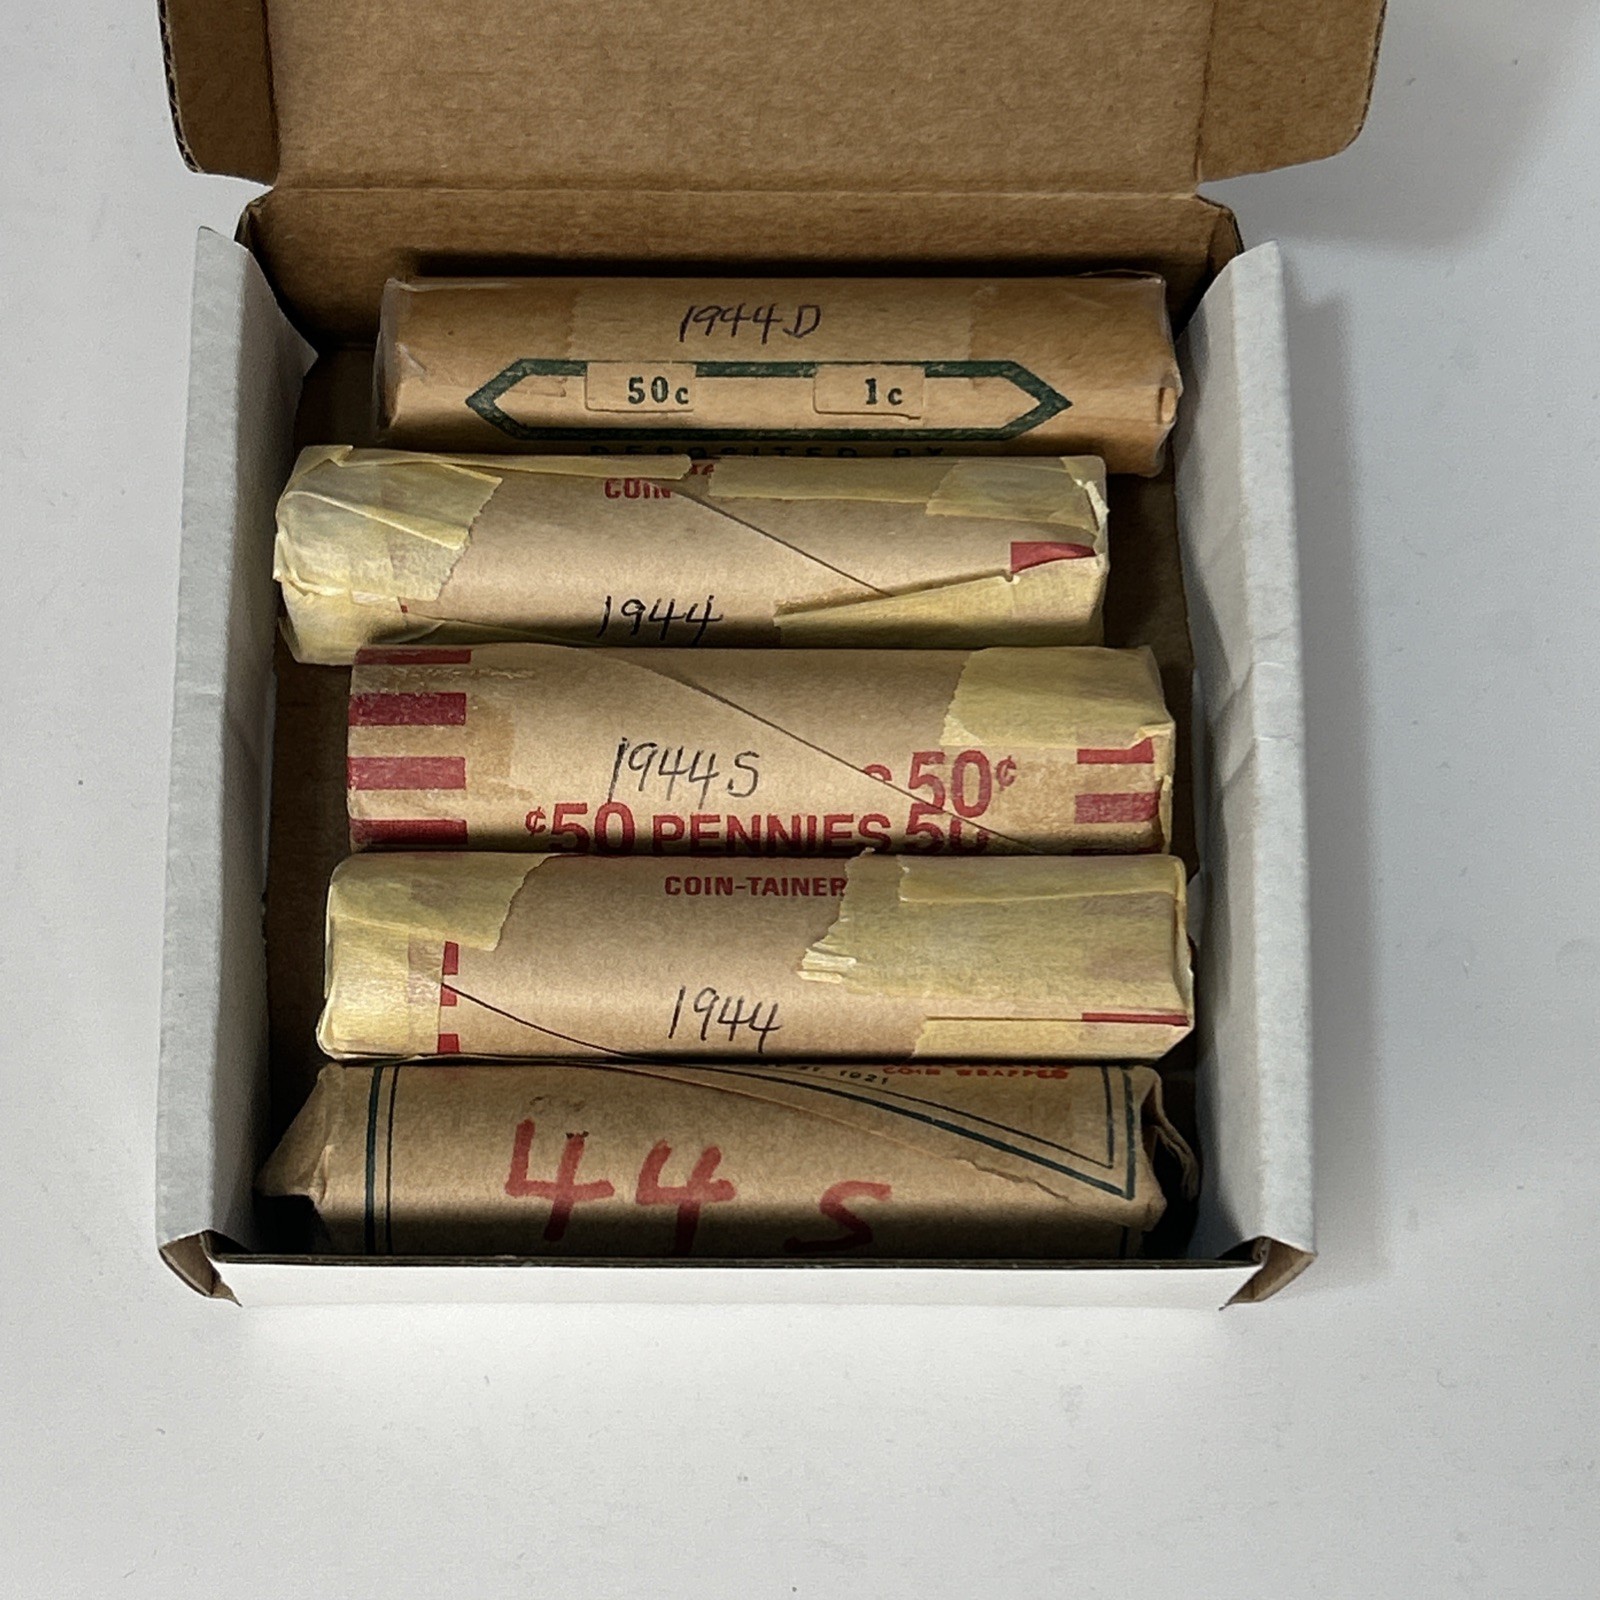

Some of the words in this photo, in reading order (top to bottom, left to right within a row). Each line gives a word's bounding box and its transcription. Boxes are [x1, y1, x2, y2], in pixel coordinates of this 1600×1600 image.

[628, 376, 689, 404] 50c
[865, 378, 902, 404] 1c
[596, 595, 723, 646] 1944
[652, 813, 892, 852] PENNIES
[664, 876, 848, 897] COIN-TAINER
[668, 985, 782, 1054] 1944
[783, 1180, 892, 1254] S
